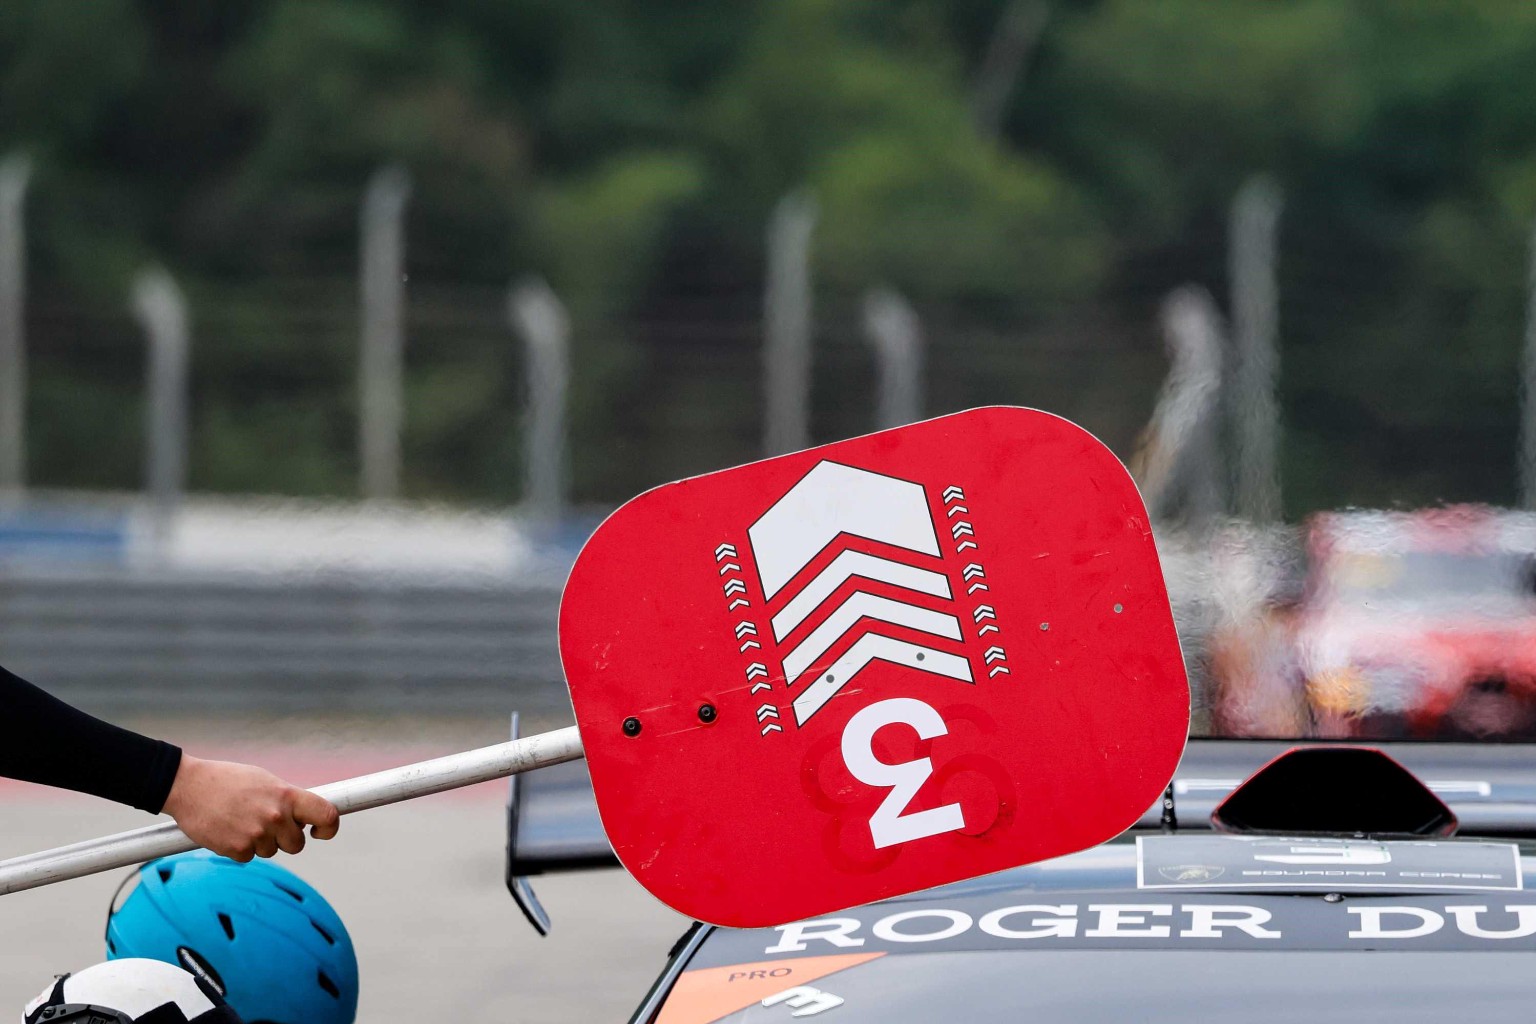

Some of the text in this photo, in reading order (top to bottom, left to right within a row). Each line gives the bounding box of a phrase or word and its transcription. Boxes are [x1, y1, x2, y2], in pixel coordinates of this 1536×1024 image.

[841, 697, 966, 849] 3
[764, 903, 1283, 954] ROGER
[728, 966, 793, 983] PRO
[761, 984, 845, 1018] 3
